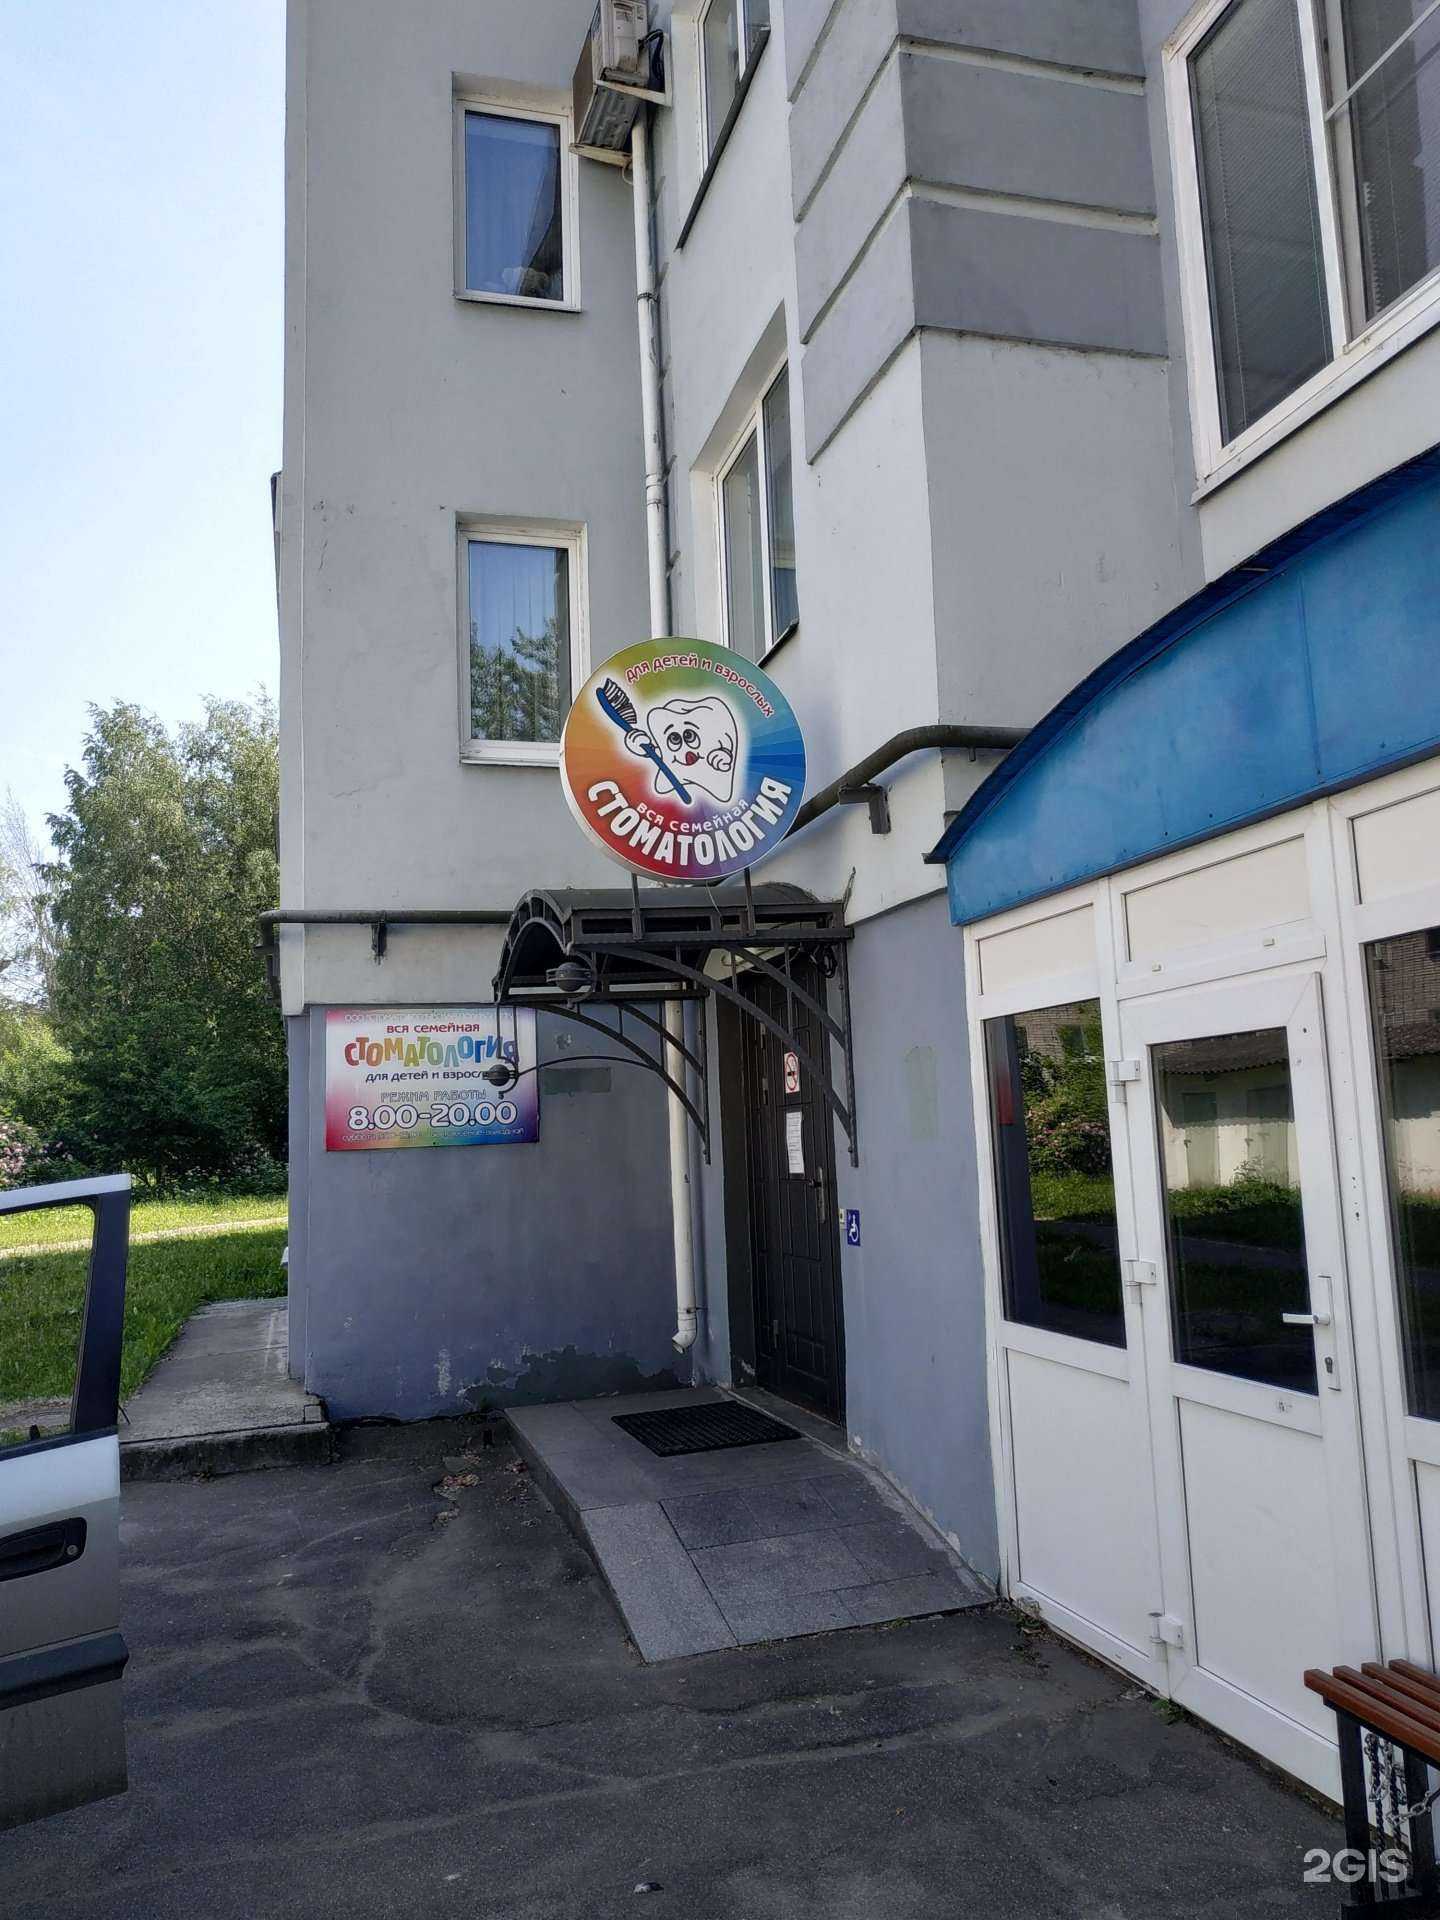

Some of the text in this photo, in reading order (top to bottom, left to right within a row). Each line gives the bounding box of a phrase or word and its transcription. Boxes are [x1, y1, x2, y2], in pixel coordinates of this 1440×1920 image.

[625, 661, 651, 683] для
[653, 653, 698, 673] детей
[714, 662, 776, 719] взрослых
[587, 776, 793, 867] СТОМАТОЛОГИЯ
[636, 799, 750, 834] вся семейная
[386, 1022, 480, 1034] вся семейная
[344, 1035, 520, 1068] СТОМАТОЛОГИЯ
[365, 1072, 389, 1083] для
[391, 1070, 429, 1082] детей
